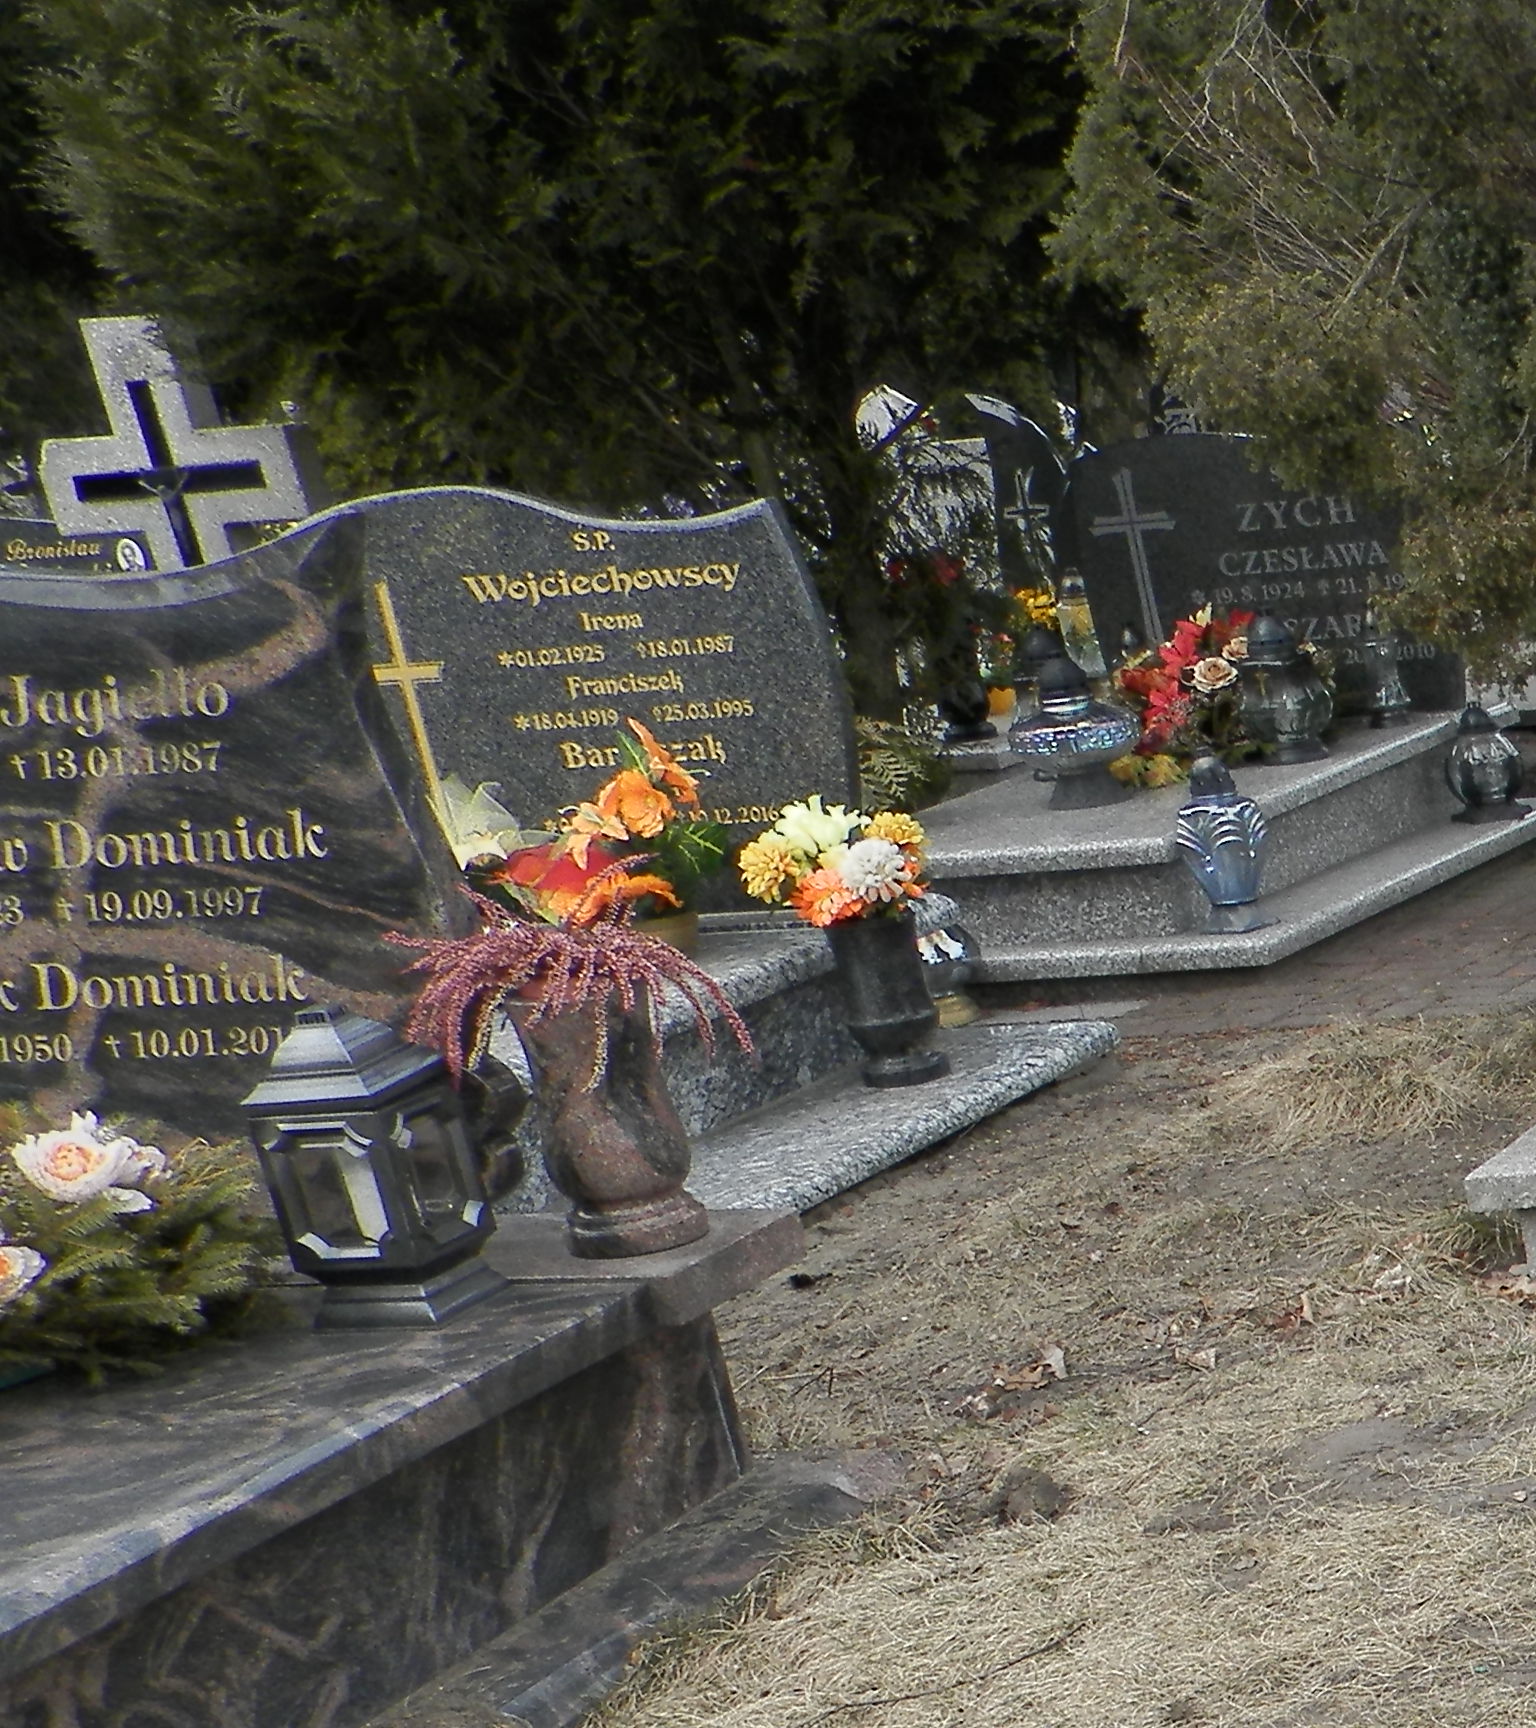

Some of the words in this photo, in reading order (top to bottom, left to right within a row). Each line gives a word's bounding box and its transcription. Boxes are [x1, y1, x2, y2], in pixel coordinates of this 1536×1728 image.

[1236, 496, 1357, 532] ZYCH
[1218, 540, 1390, 577] CZESŁAWA
[462, 562, 741, 607] Wojciechowscy
[579, 611, 645, 633] Irena
[566, 670, 685, 700] Franciszek
[40, 742, 221, 780] 13.01.1987
[44, 806, 329, 870] Dominiak
[85, 885, 264, 923] 19.09.1997
[30, 953, 309, 1011] Dominiak
[131, 1026, 286, 1059] 10.01.201
